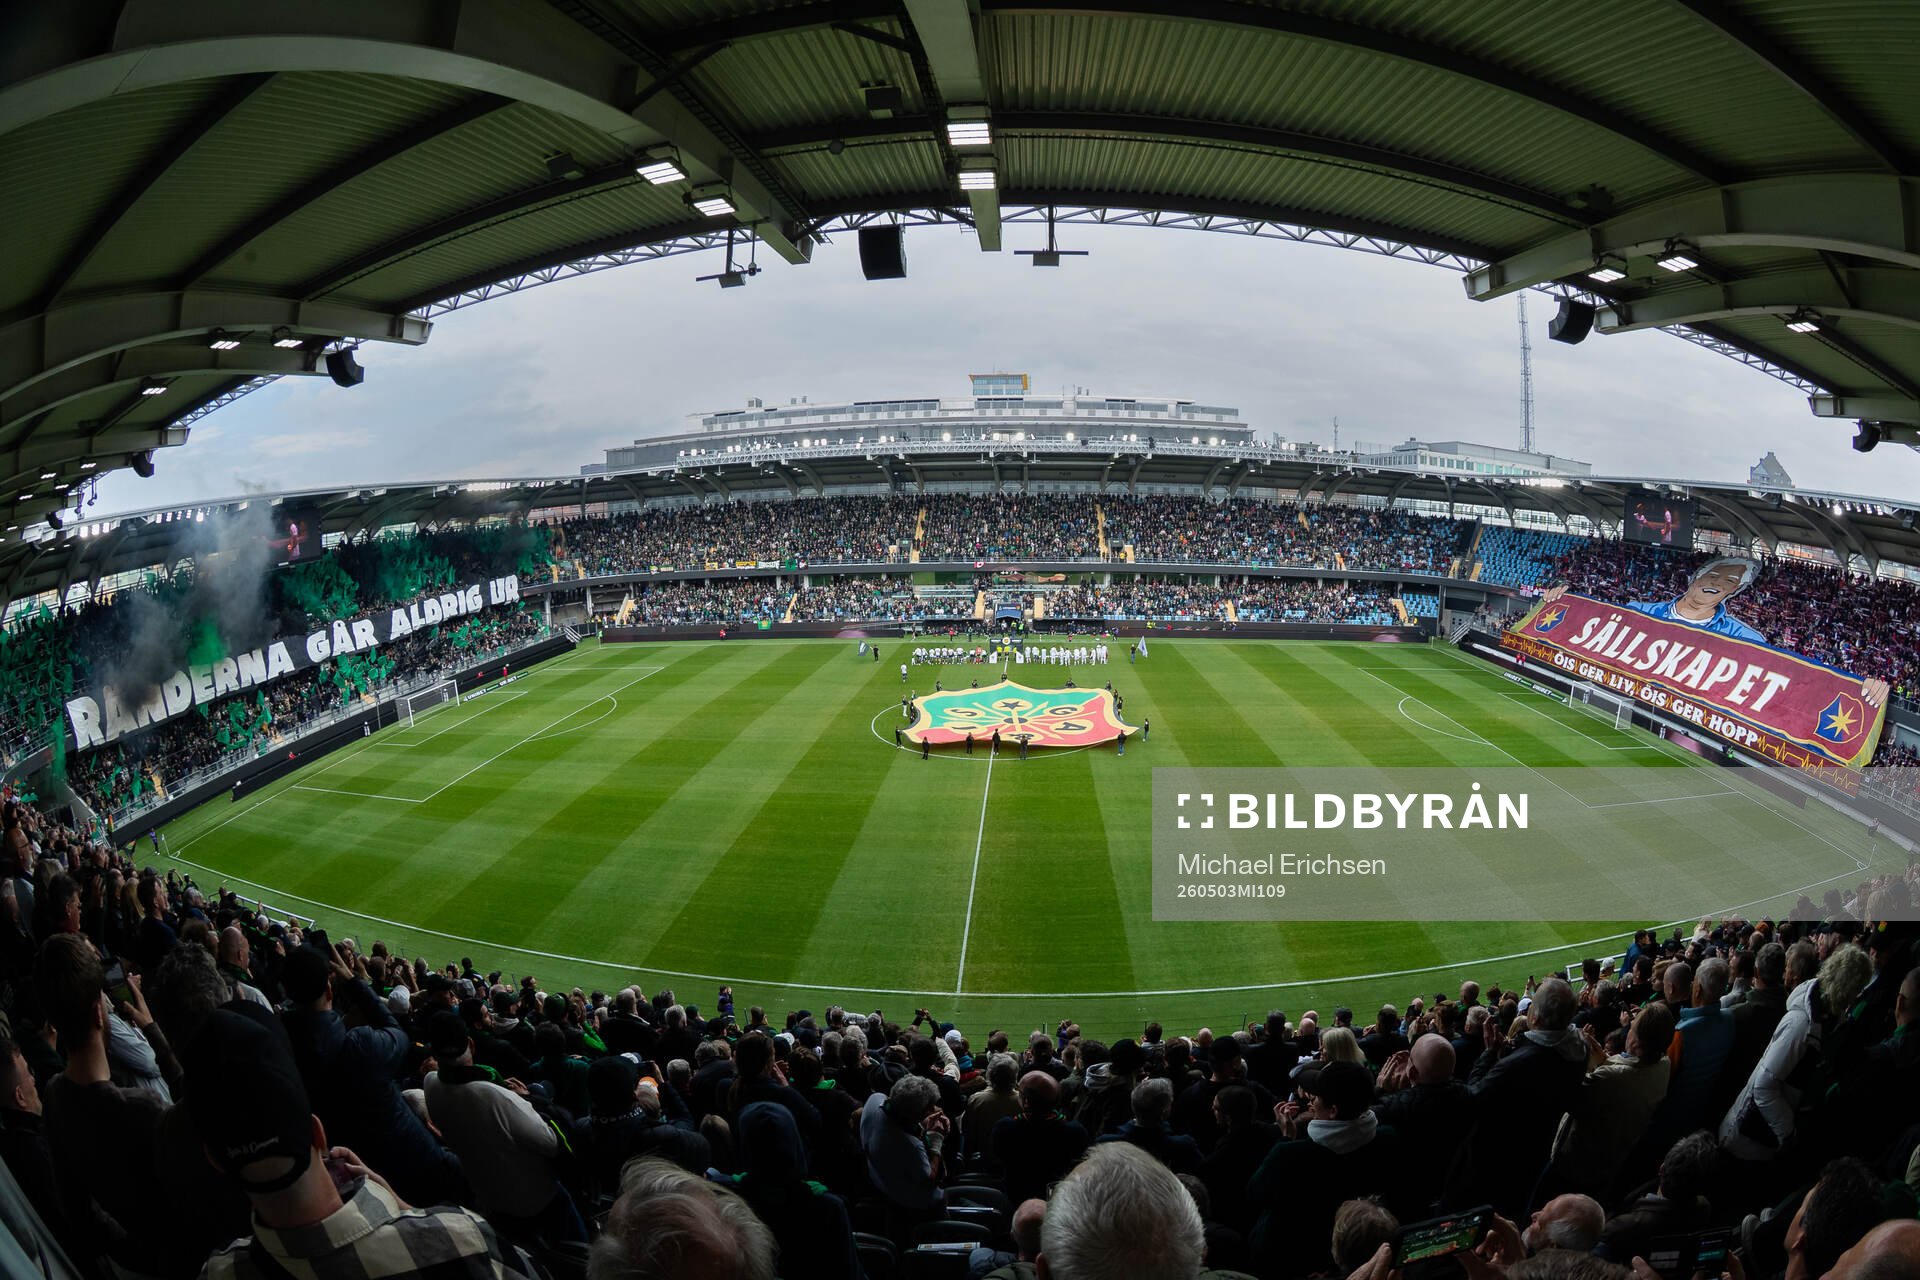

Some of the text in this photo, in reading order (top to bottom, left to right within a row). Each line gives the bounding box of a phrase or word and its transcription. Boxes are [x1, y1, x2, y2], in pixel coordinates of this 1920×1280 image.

[306, 619, 379, 663] GÅR
[390, 584, 483, 640] ALDRIG
[490, 574, 520, 605] UR
[1569, 613, 1790, 712] SÄLLSKAPET
[1554, 651, 1759, 746] ÖIS GER LIV, ÖIS GER HOPP
